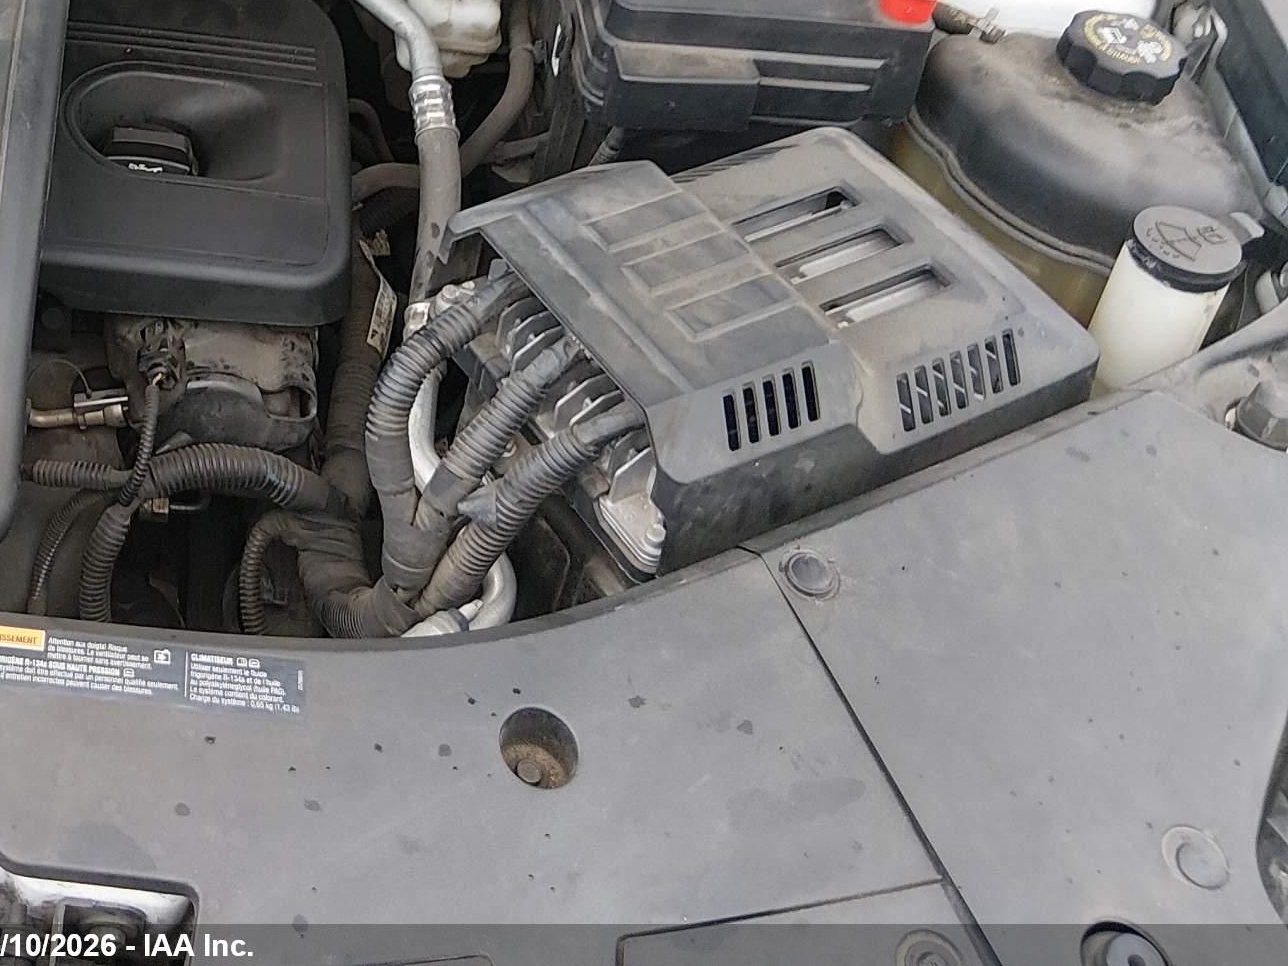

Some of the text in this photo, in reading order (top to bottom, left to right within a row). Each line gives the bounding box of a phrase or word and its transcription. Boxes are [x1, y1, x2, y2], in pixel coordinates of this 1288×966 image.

[48, 637, 73, 646] Attention
[108, 644, 126, 653] Risque
[56, 645, 84, 654] blessures.
[95, 649, 125, 659] ventilateur
[127, 653, 139, 661] peut
[24, 658, 46, 667] R-134a
[48, 660, 65, 669] SOUS
[66, 662, 87, 672] HAUTE
[88, 665, 119, 676] PRESSION
[47, 651, 66, 659] mettre
[72, 654, 92, 662] tourner
[110, 659, 151, 669] avertissement.
[191, 653, 232, 665] CLIMATISEUR
[24, 666, 35, 674] doit
[74, 672, 83, 680] par
[94, 674, 122, 684] personnel
[146, 680, 178, 690] seulement.
[190, 663, 210, 671] Utiliser
[212, 665, 242, 674] seulement
[251, 669, 266, 677] fluide
[223, 674, 244, 682] R-134a
[0, 671, 31, 681] d'entretien
[32, 675, 64, 685] incorrectes
[66, 678, 89, 688] peuvent
[90, 682, 109, 690] causer
[123, 685, 152, 695] blessures.
[189, 693, 210, 703] Charge
[266, 701, 272, 710] kg
[224, 689, 248, 698] contient
[258, 693, 284, 701] colorant.
